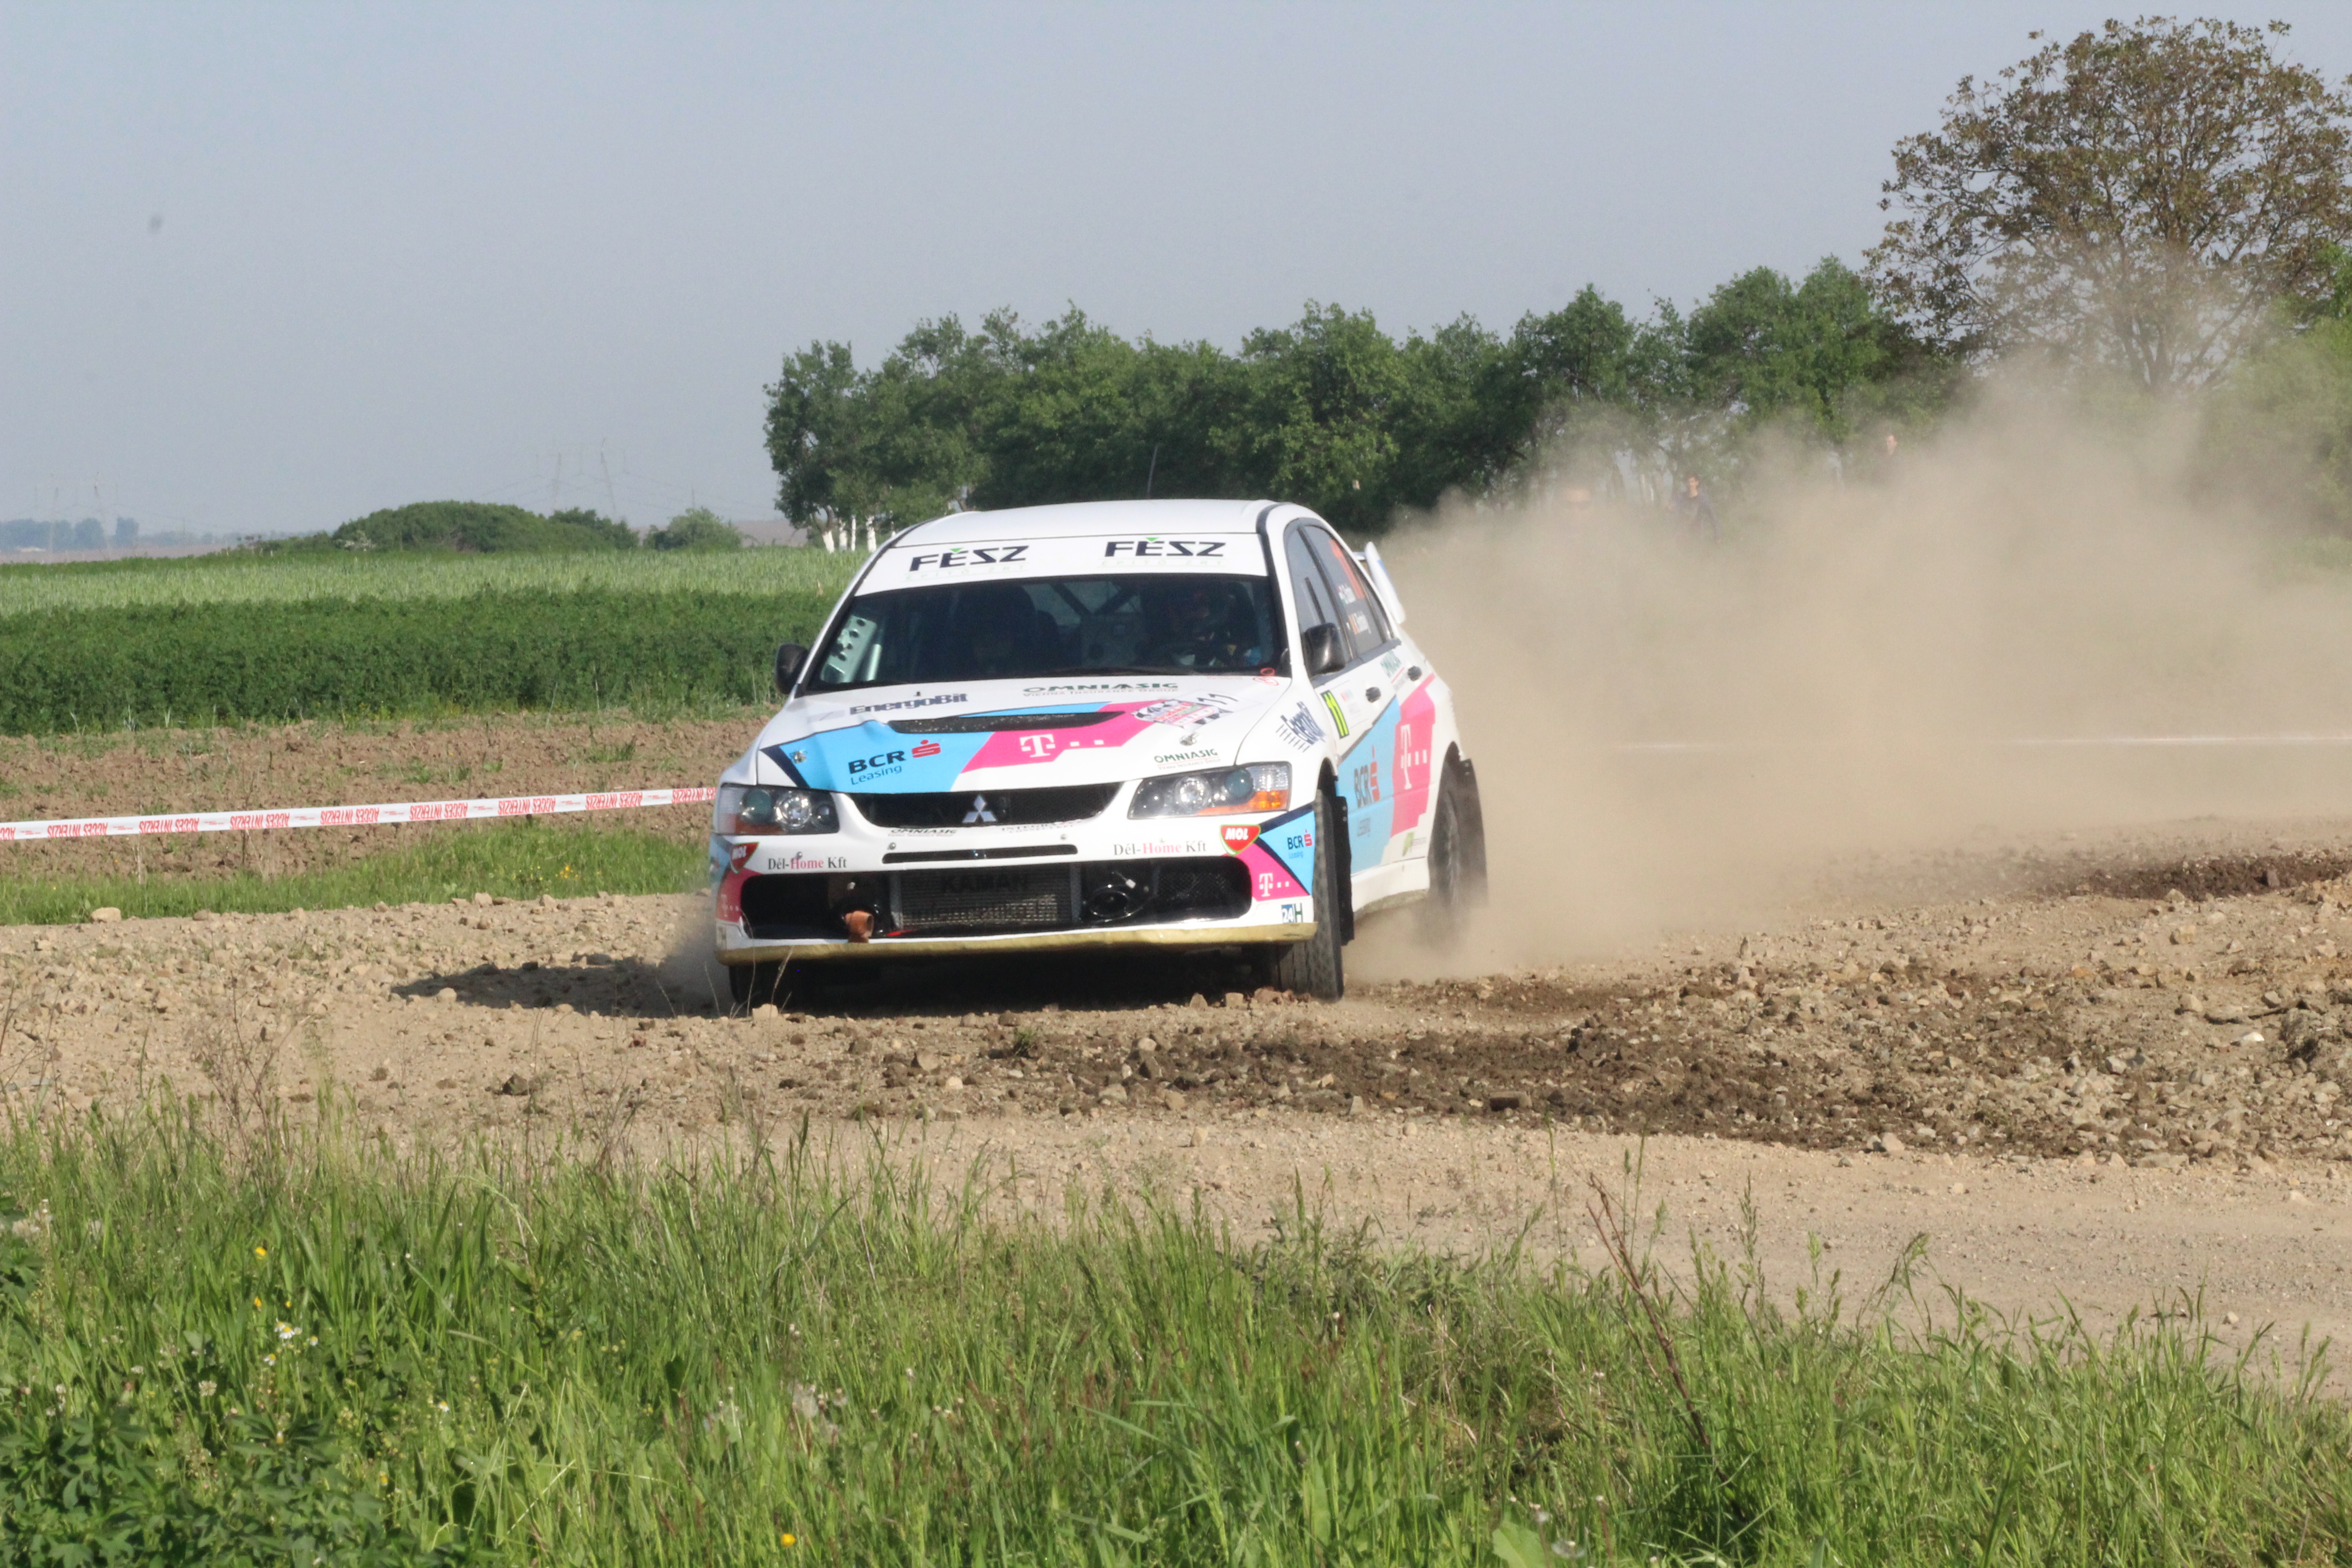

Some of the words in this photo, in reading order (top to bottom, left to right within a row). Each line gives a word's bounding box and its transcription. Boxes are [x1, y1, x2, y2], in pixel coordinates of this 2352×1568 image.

[1023, 683, 1178, 692] OMNIASIG
[850, 693, 968, 715] EnergoBit
[848, 750, 906, 774] BCR
[1154, 749, 1218, 763] OMNIASIG
[850, 765, 902, 785] Leasing
[498, 799, 530, 816] INTERZIS
[533, 798, 556, 813] ACCES
[586, 794, 617, 810] INTERZIS
[619, 792, 643, 808] ACCES
[321, 810, 353, 826] INTERZIS
[356, 808, 379, 824] ACCES
[410, 805, 442, 821] INTERZIS
[444, 803, 468, 819] ACCES
[139, 820, 173, 834] INTERZIS
[175, 818, 200, 833] ACCES
[230, 815, 264, 830] INTERZIS
[266, 813, 290, 829] ACCES
[0, 827, 15, 840] ACC
[47, 824, 81, 838] INTERZIS
[83, 823, 108, 837] ACCES
[1225, 828, 1249, 840] MOL
[1114, 843, 1181, 855] Dél-Home
[1186, 841, 1206, 853] Kft
[1288, 835, 1303, 850] BCR
[769, 858, 824, 870] Dél-Home
[828, 857, 847, 868] Kft
